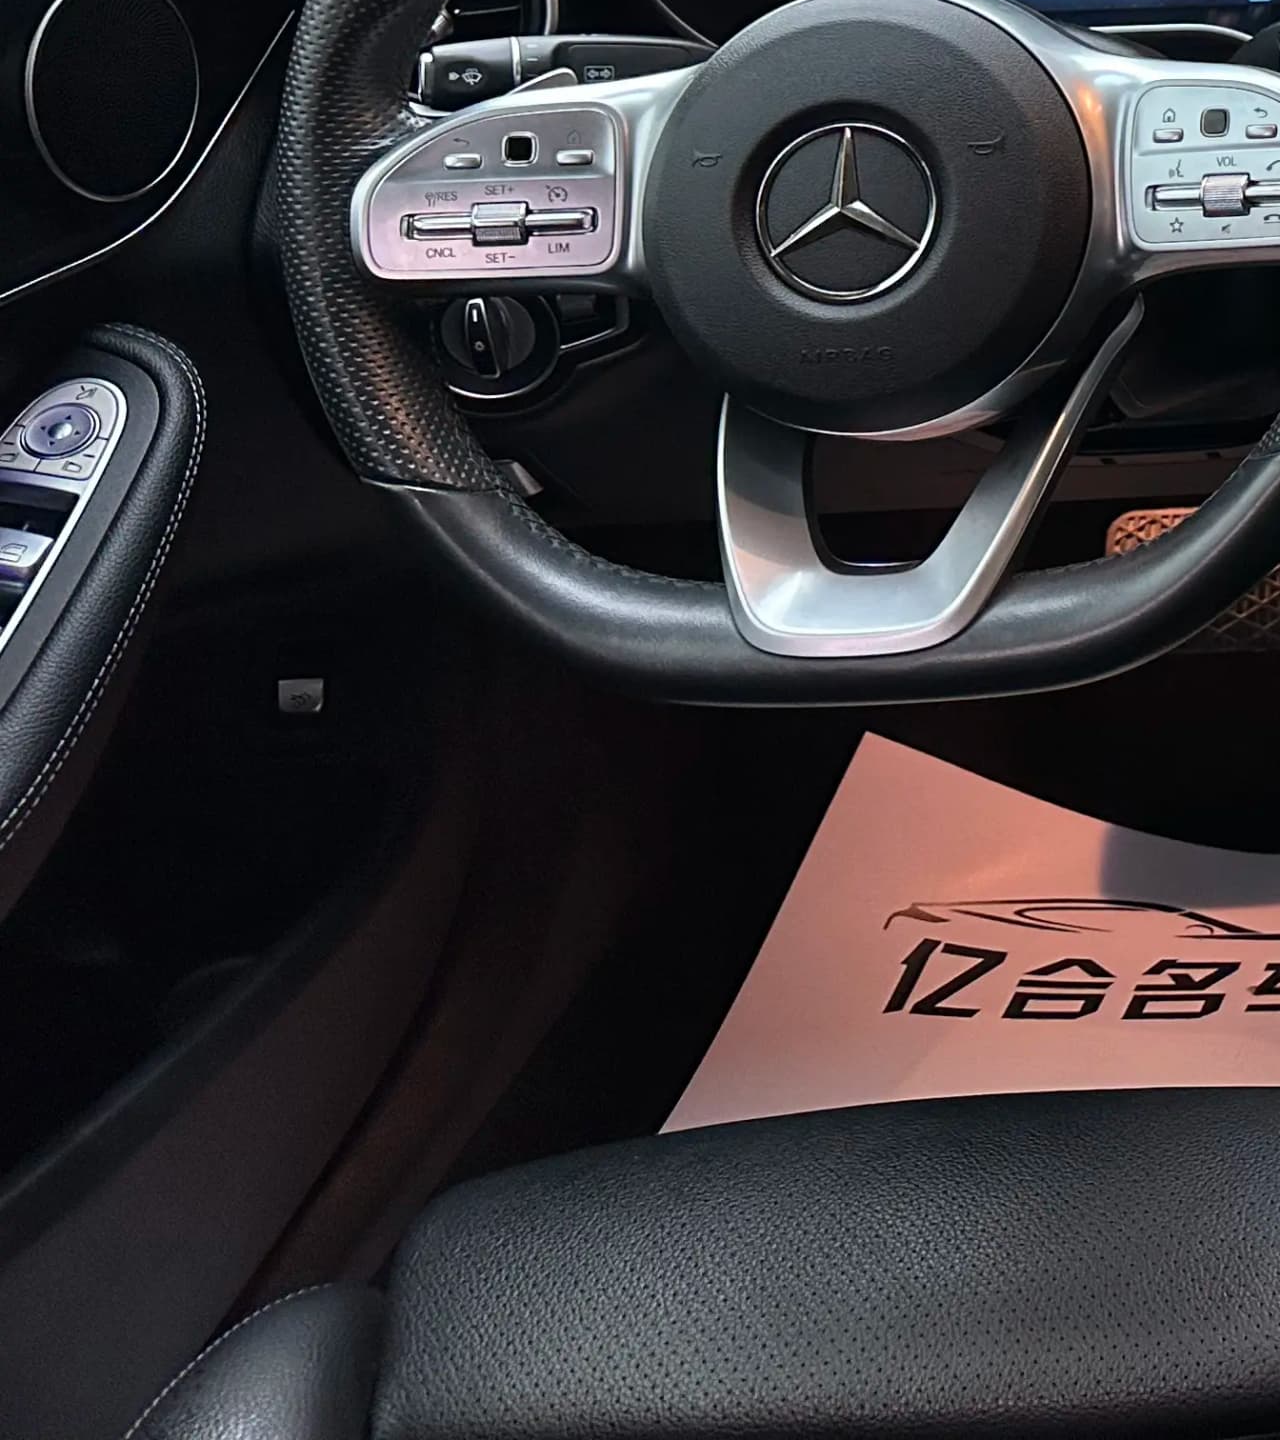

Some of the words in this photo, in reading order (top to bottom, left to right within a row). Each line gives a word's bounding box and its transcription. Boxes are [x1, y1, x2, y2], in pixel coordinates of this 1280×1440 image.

[1216, 157, 1237, 168] VOL
[485, 184, 515, 196] SET+
[426, 247, 456, 259] CNCL
[548, 242, 570, 254] LIM
